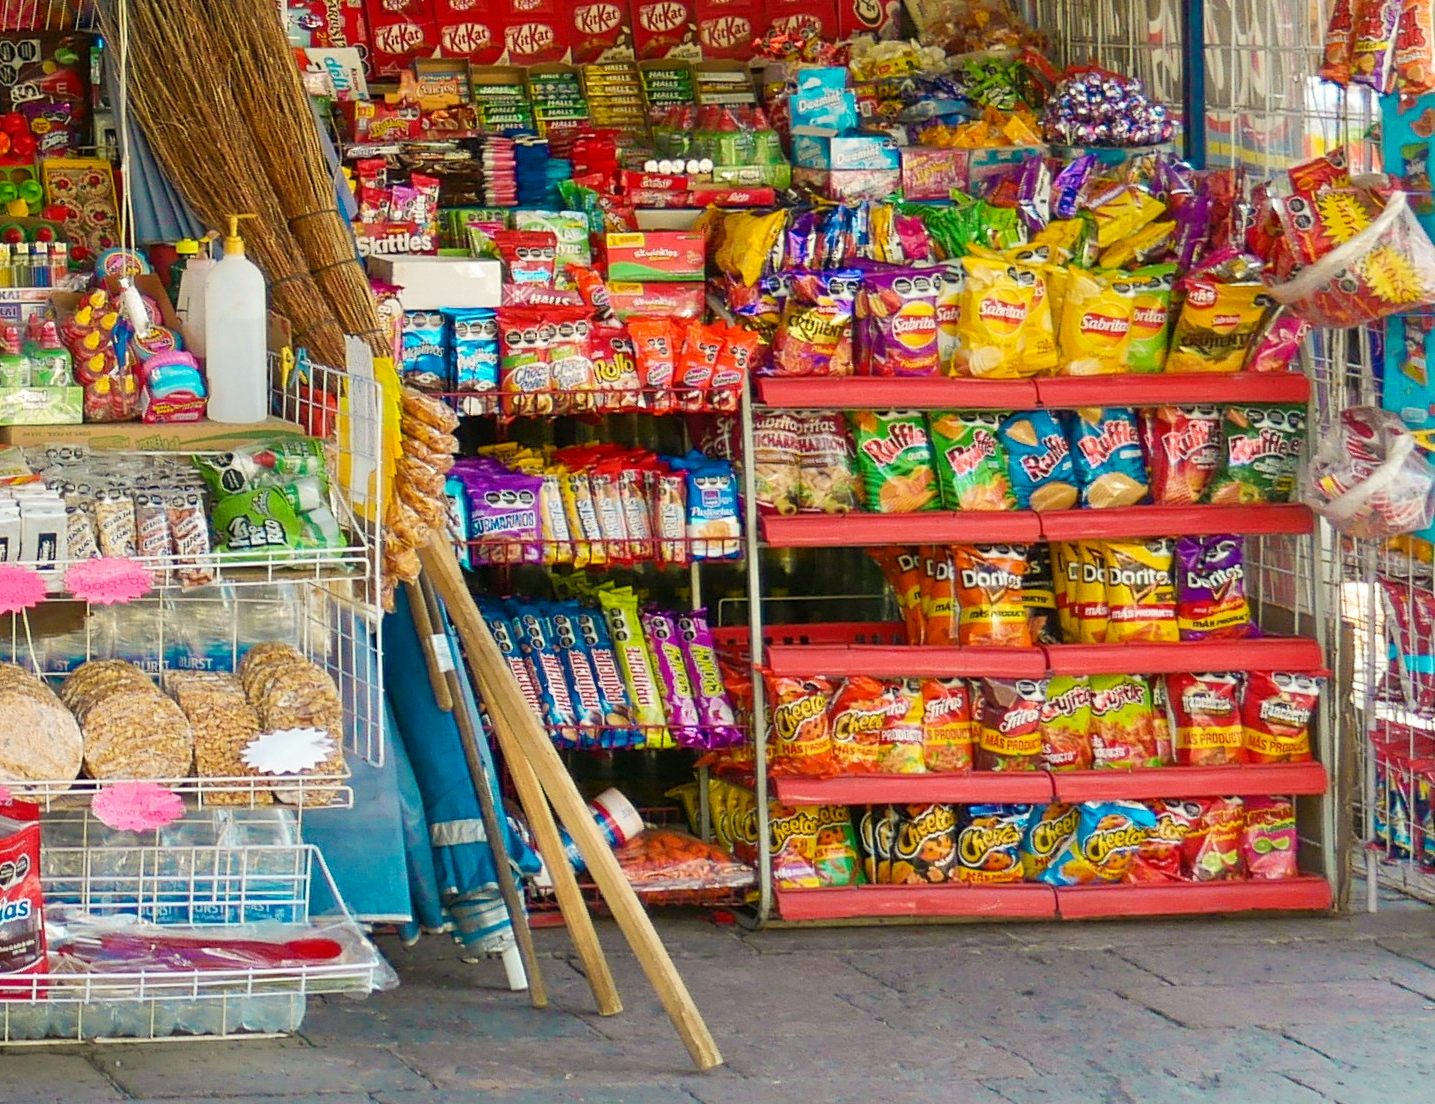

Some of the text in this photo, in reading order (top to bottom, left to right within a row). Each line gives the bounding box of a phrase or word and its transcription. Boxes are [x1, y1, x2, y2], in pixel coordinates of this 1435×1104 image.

[581, 6, 617, 31] KitKat
[646, 5, 682, 30] KitKat
[381, 23, 421, 52] KitKat
[447, 23, 487, 51] KitKat
[511, 23, 552, 53] KitKat
[709, 18, 747, 46] KitKat
[356, 234, 432, 255] Skittles
[634, 248, 679, 257] skwinkles
[531, 295, 571, 305] HALLS
[980, 302, 1027, 320] Sabritas
[1213, 315, 1240, 325] Sabritas
[594, 354, 634, 382] Rollo
[472, 512, 534, 535] SUBMARINOS
[962, 570, 1023, 589] Doritos
[1187, 566, 1243, 589] Doritos
[925, 696, 963, 722] Fritos
[999, 707, 1040, 734] Fritos
